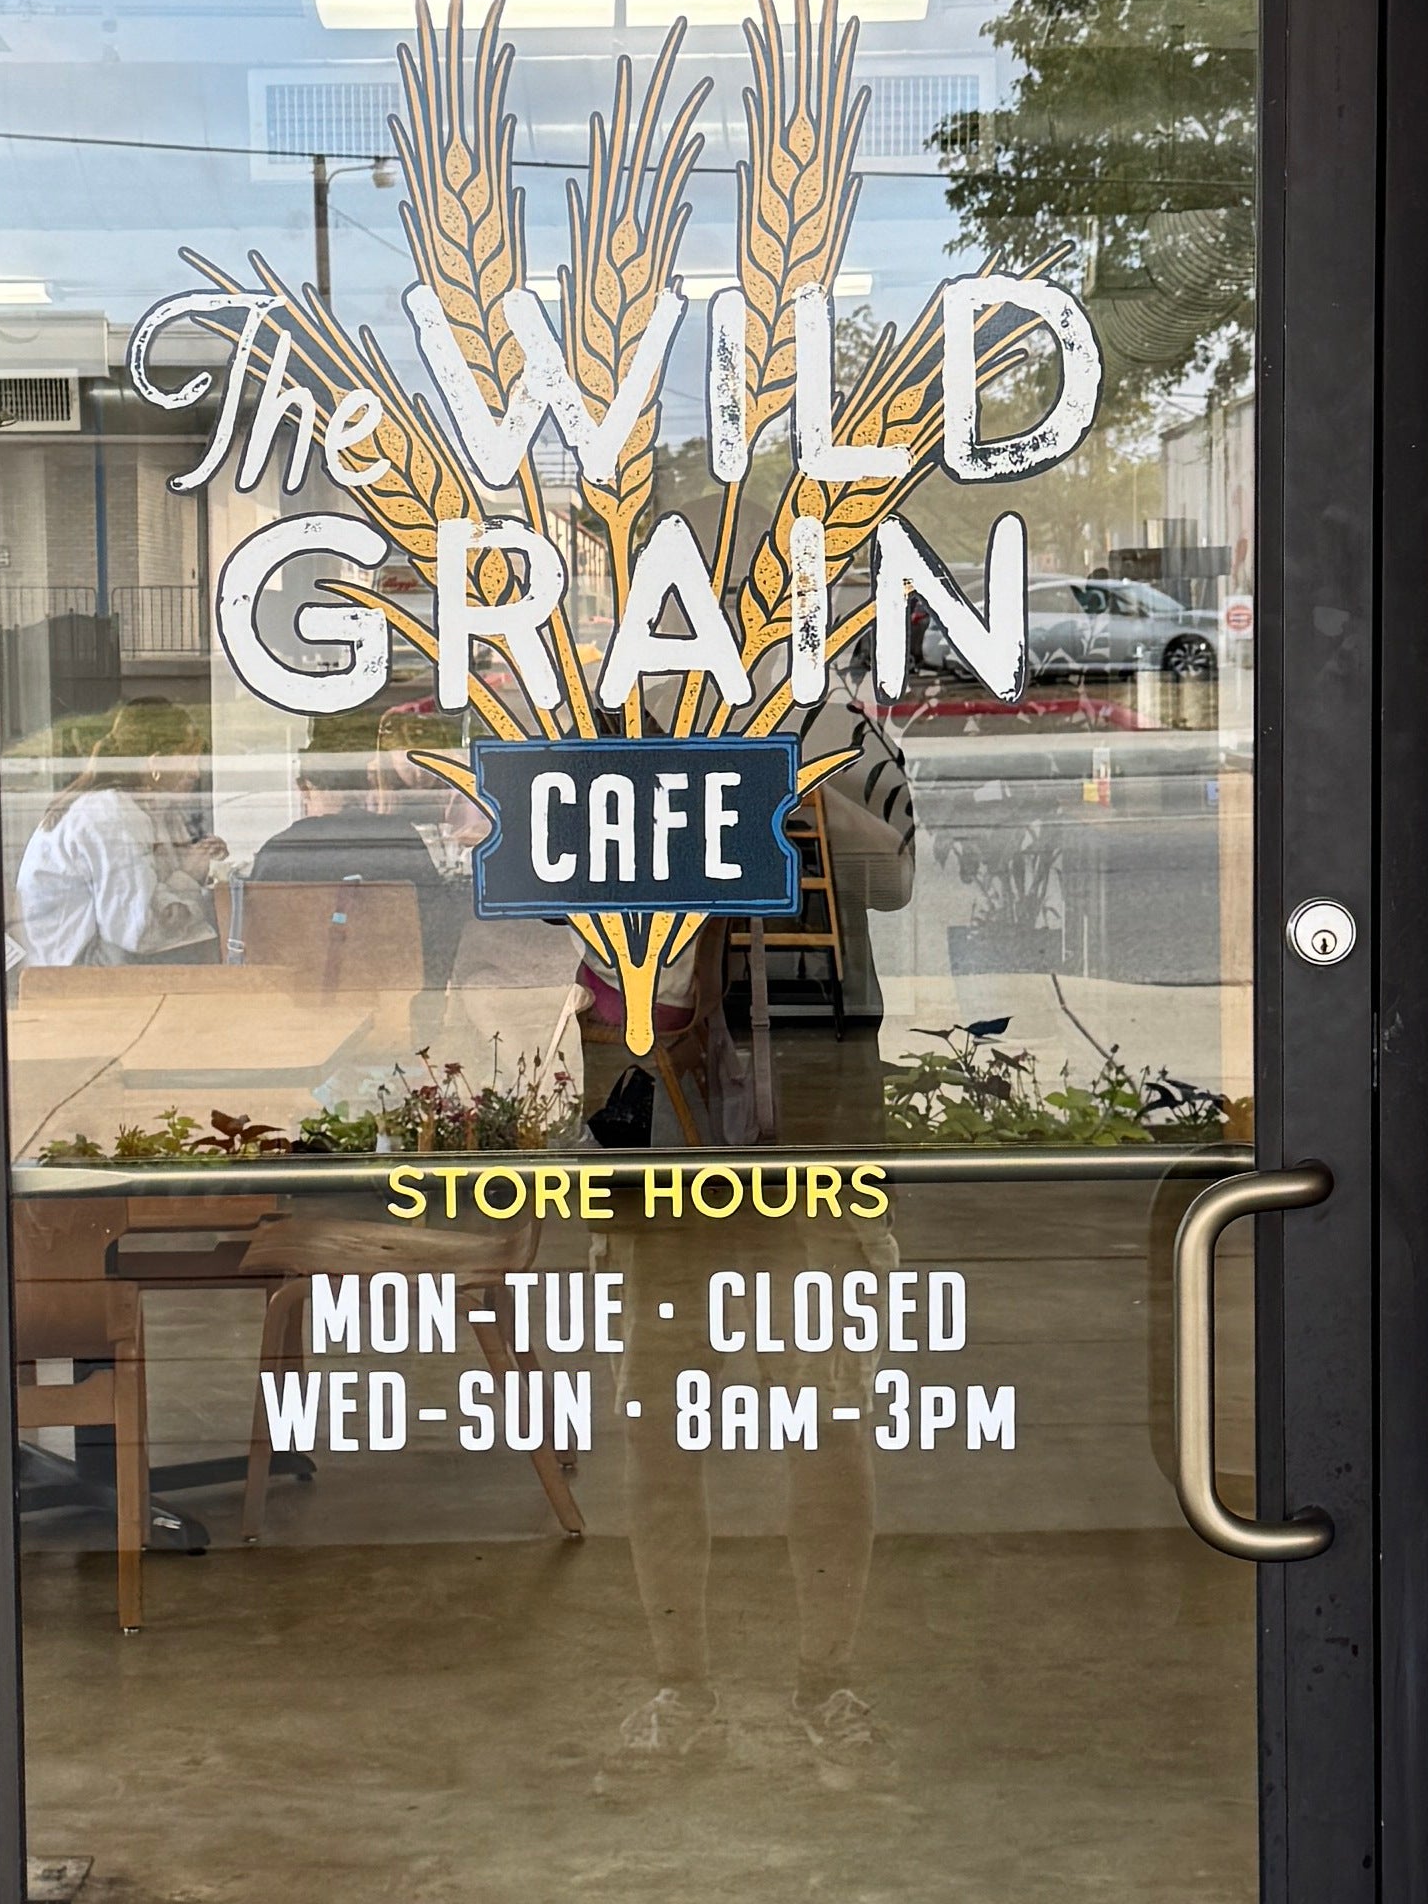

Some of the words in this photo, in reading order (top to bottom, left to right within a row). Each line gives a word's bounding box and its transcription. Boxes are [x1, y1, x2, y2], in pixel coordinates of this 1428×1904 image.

[130, 292, 385, 492] The
[406, 276, 1102, 489] WILD
[217, 510, 1027, 714] GRAIN
[529, 771, 743, 884] CAFE
[387, 1164, 612, 1221] STORE
[643, 1162, 890, 1219] HOURS
[310, 1271, 625, 1355] MON-TUE
[707, 1269, 967, 1353] CLOSED
[259, 1369, 592, 1453] WED-SUN
[674, 1368, 1016, 1452] 8AM-3PM
